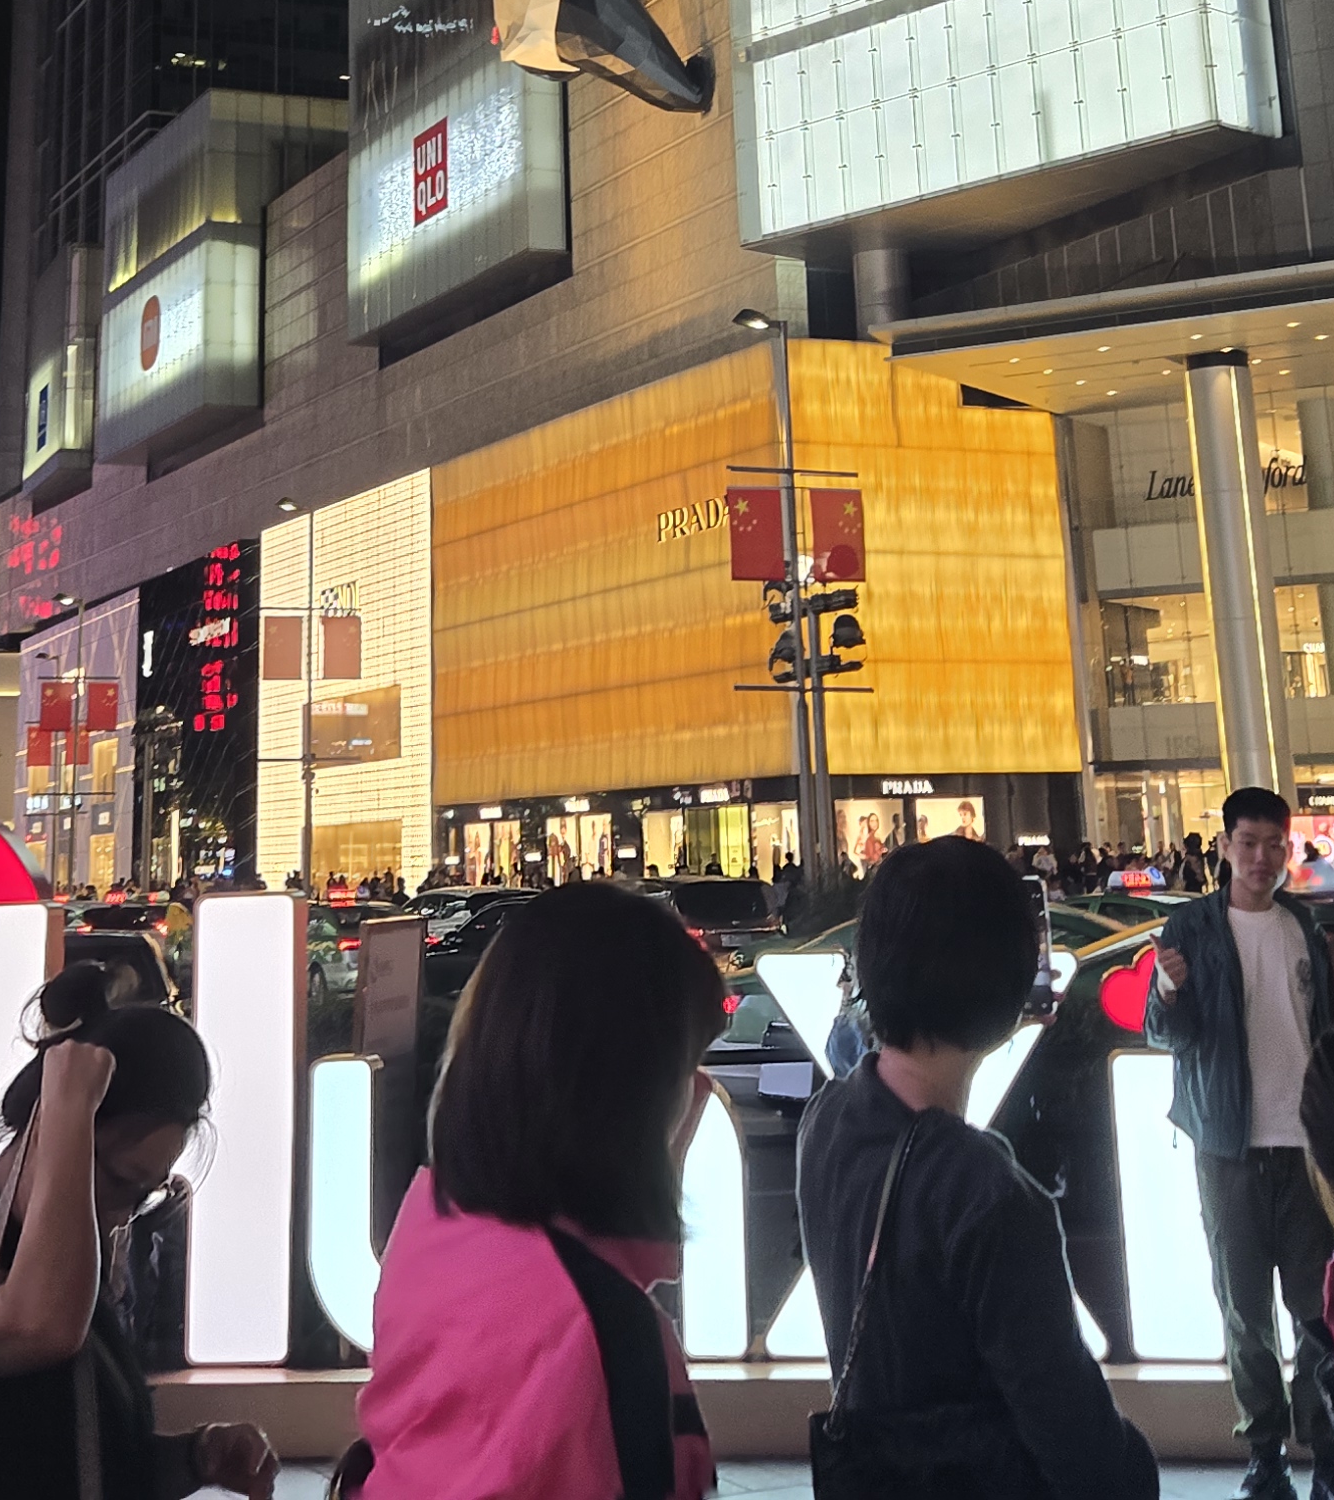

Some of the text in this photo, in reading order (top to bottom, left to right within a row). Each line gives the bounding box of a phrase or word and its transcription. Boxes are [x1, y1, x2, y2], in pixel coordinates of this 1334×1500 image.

[416, 132, 443, 176] UNI
[416, 169, 445, 216] QLO
[1145, 455, 1308, 501] Lane ford
[882, 780, 935, 796] PRADA
